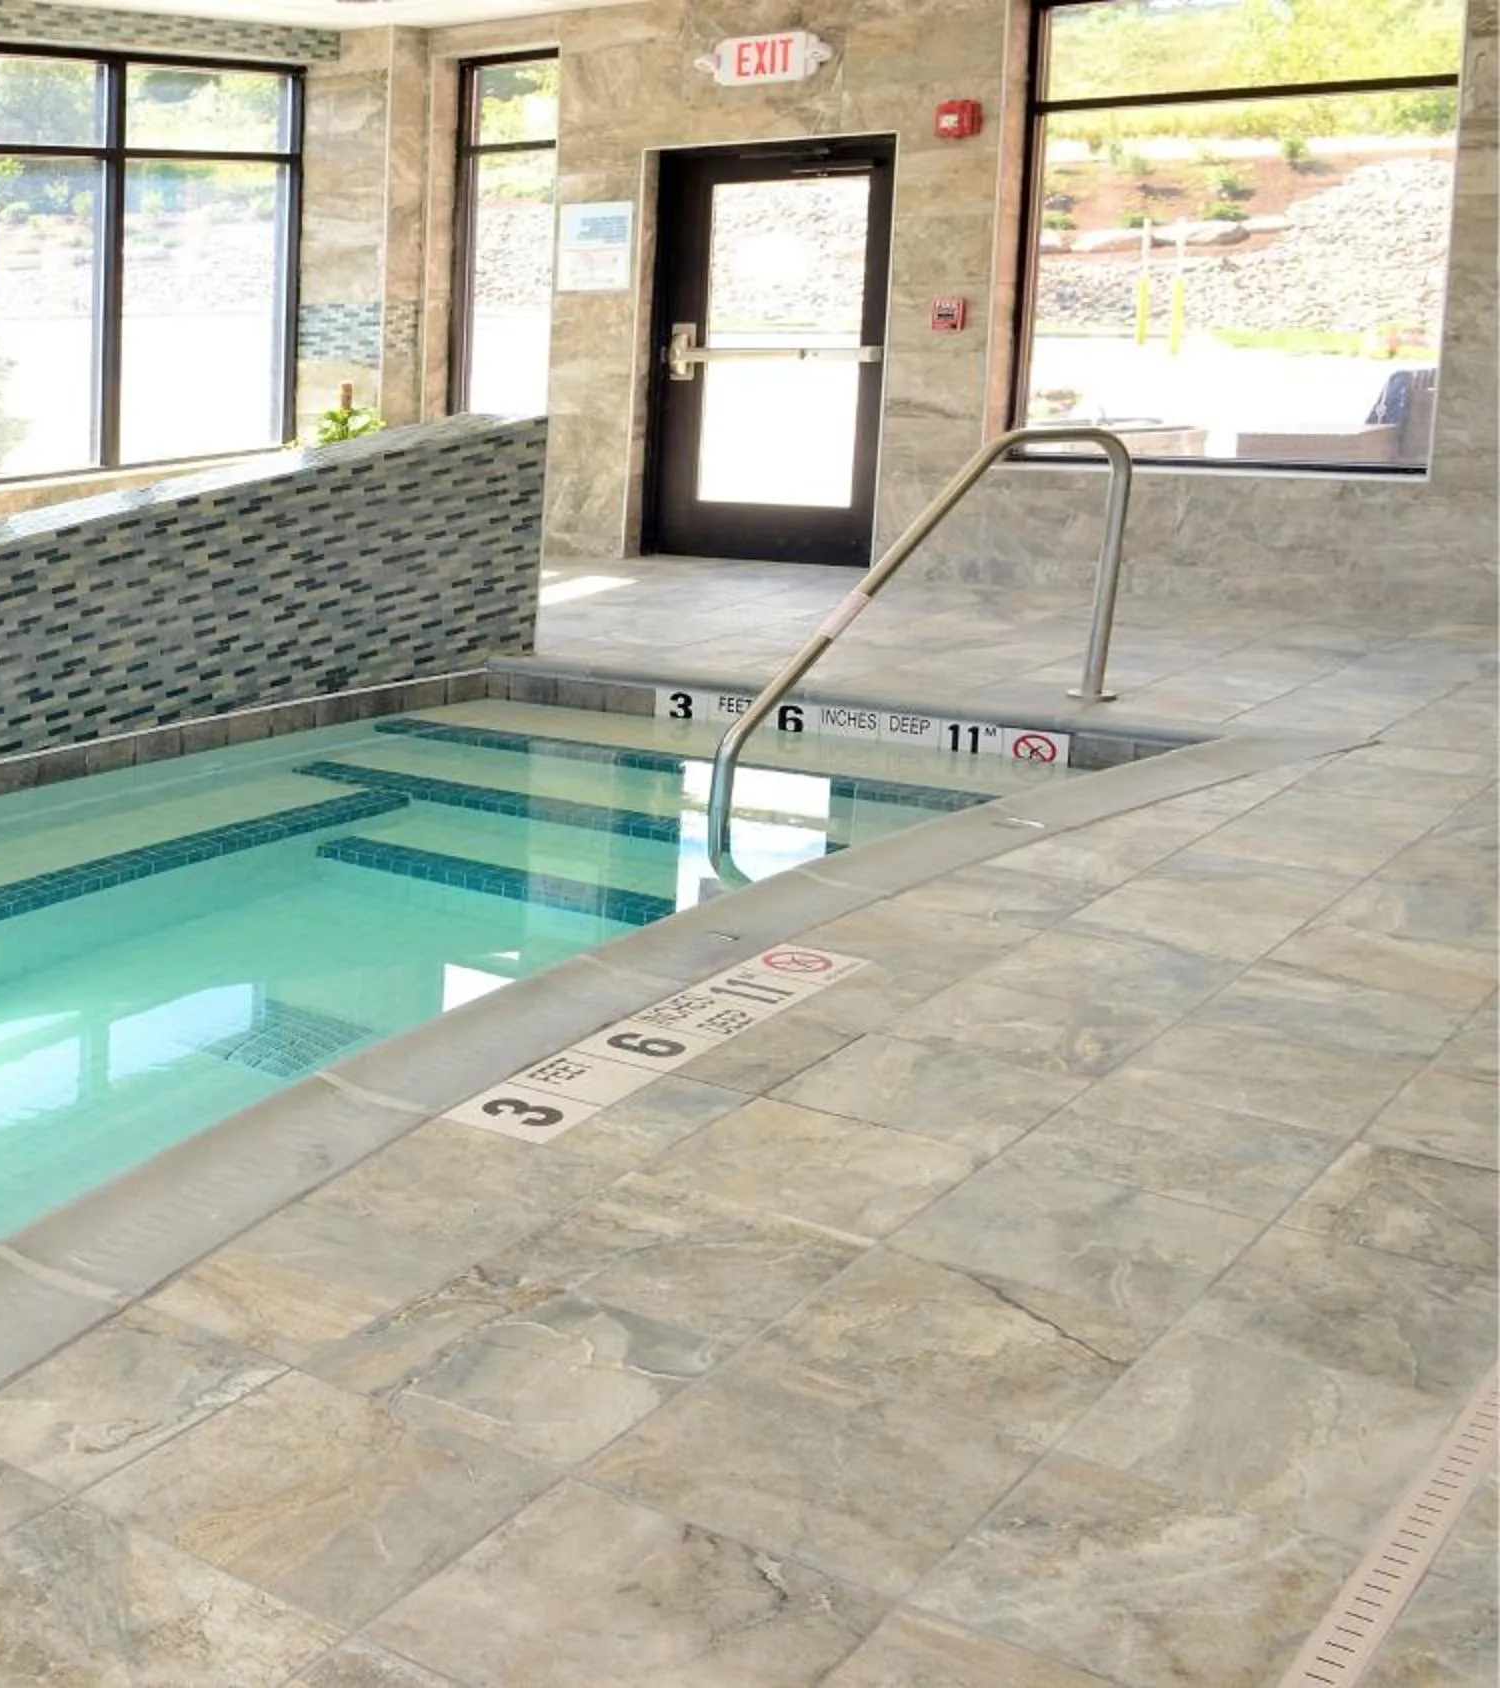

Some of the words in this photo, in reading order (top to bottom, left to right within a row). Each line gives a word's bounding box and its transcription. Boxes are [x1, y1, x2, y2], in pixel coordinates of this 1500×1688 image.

[736, 38, 794, 77] EXIT
[669, 691, 693, 719] 3
[718, 695, 753, 714] FEET
[778, 705, 804, 733] 6
[821, 708, 877, 731] INCHES
[889, 715, 931, 736] DEEP
[482, 1098, 564, 1127] 3
[528, 1057, 592, 1084] FEET
[606, 1032, 687, 1058] 6
[697, 1009, 754, 1035] DEEP
